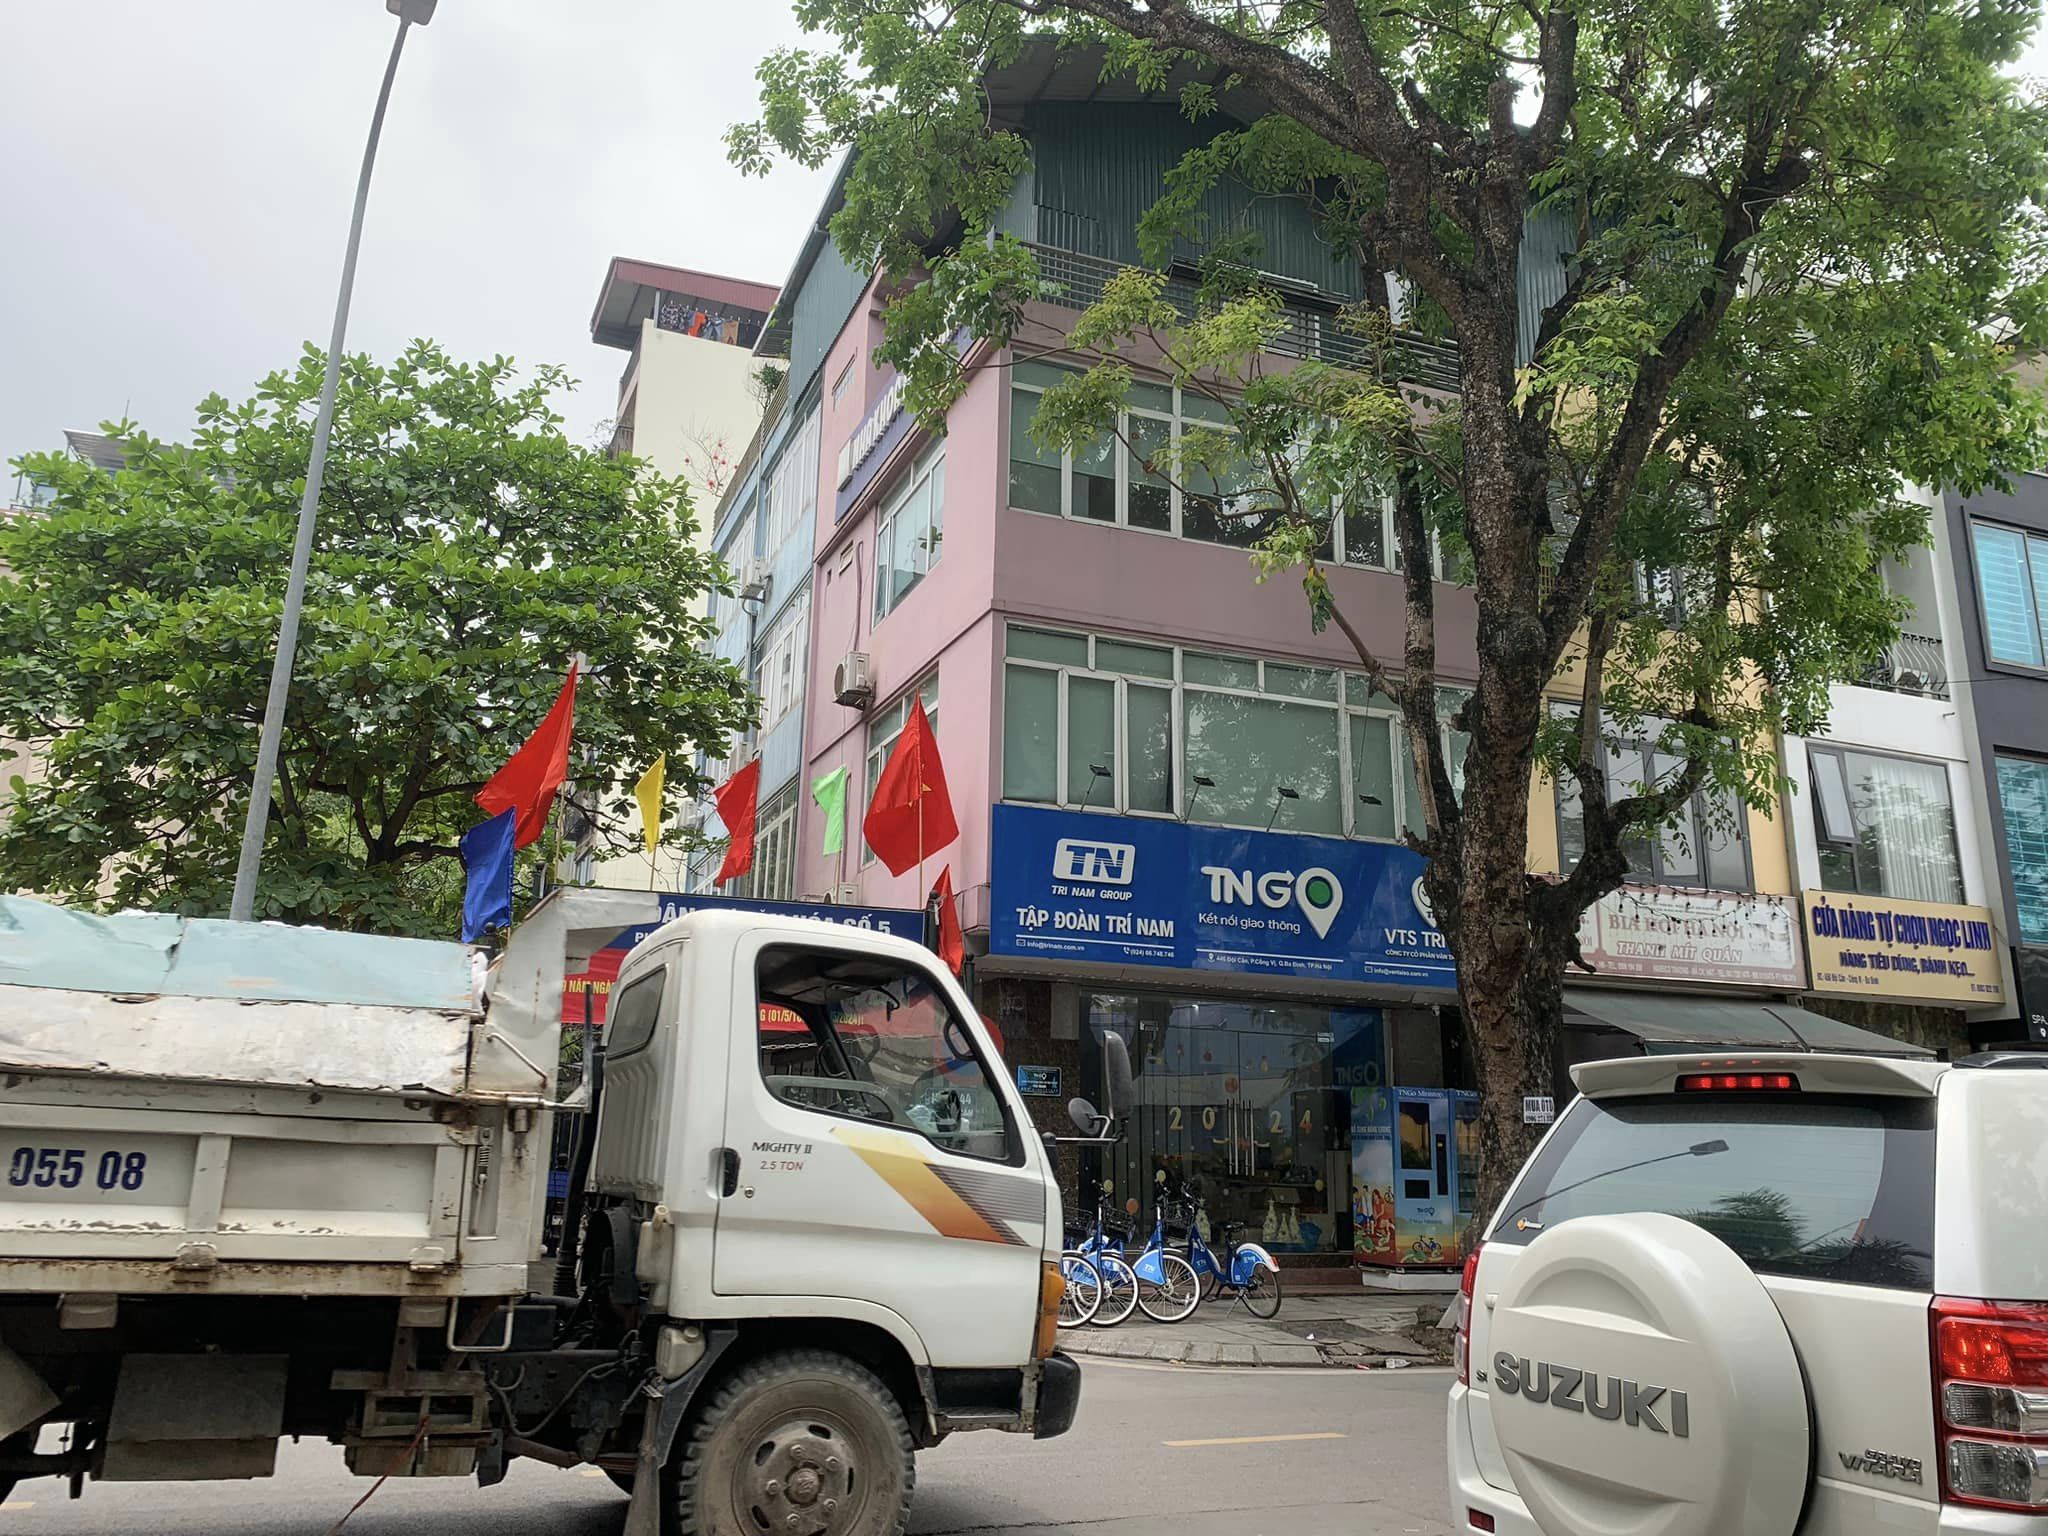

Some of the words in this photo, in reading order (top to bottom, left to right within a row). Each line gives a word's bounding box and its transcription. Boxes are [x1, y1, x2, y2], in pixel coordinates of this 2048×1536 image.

[1051, 885, 1067, 896] TRI
[1072, 886, 1095, 898] NAM
[1100, 889, 1132, 901] GROUP
[1200, 866, 1344, 940] TNGO
[878, 921, 890, 935] 5
[1016, 905, 1048, 932] TẬP
[1054, 908, 1099, 932] ĐOÀN
[1105, 909, 1132, 935] TRÍ
[1137, 918, 1174, 938] NAM
[1198, 913, 1218, 925] Kết
[1220, 914, 1238, 926] nối
[1240, 917, 1264, 930] giao
[1268, 919, 1300, 934] thông
[1608, 914, 1640, 932] BIA
[1812, 896, 1840, 938] CỬA
[1839, 902, 1874, 941] HÀNG
[1876, 910, 1893, 948] TỰ
[1895, 913, 1928, 949] CHỌN
[1929, 917, 1962, 952] NGỌC
[1963, 920, 1992, 951] LINH
[1384, 928, 1417, 947] VTS
[1670, 941, 1697, 960] MÍT
[1703, 945, 1742, 964] QUÁN
[1839, 949, 1867, 969] HÀNG
[1920, 957, 1947, 974] BÁNH
[1525, 1099, 1540, 1112] MUA
[752, 1142, 802, 1154] MIGHTY
[9, 1147, 86, 1189] 055
[97, 1150, 147, 1190] 08
[760, 1160, 776, 1170] 2.5
[780, 1161, 804, 1171] TON
[1493, 1351, 1689, 1438] SUZUKI
